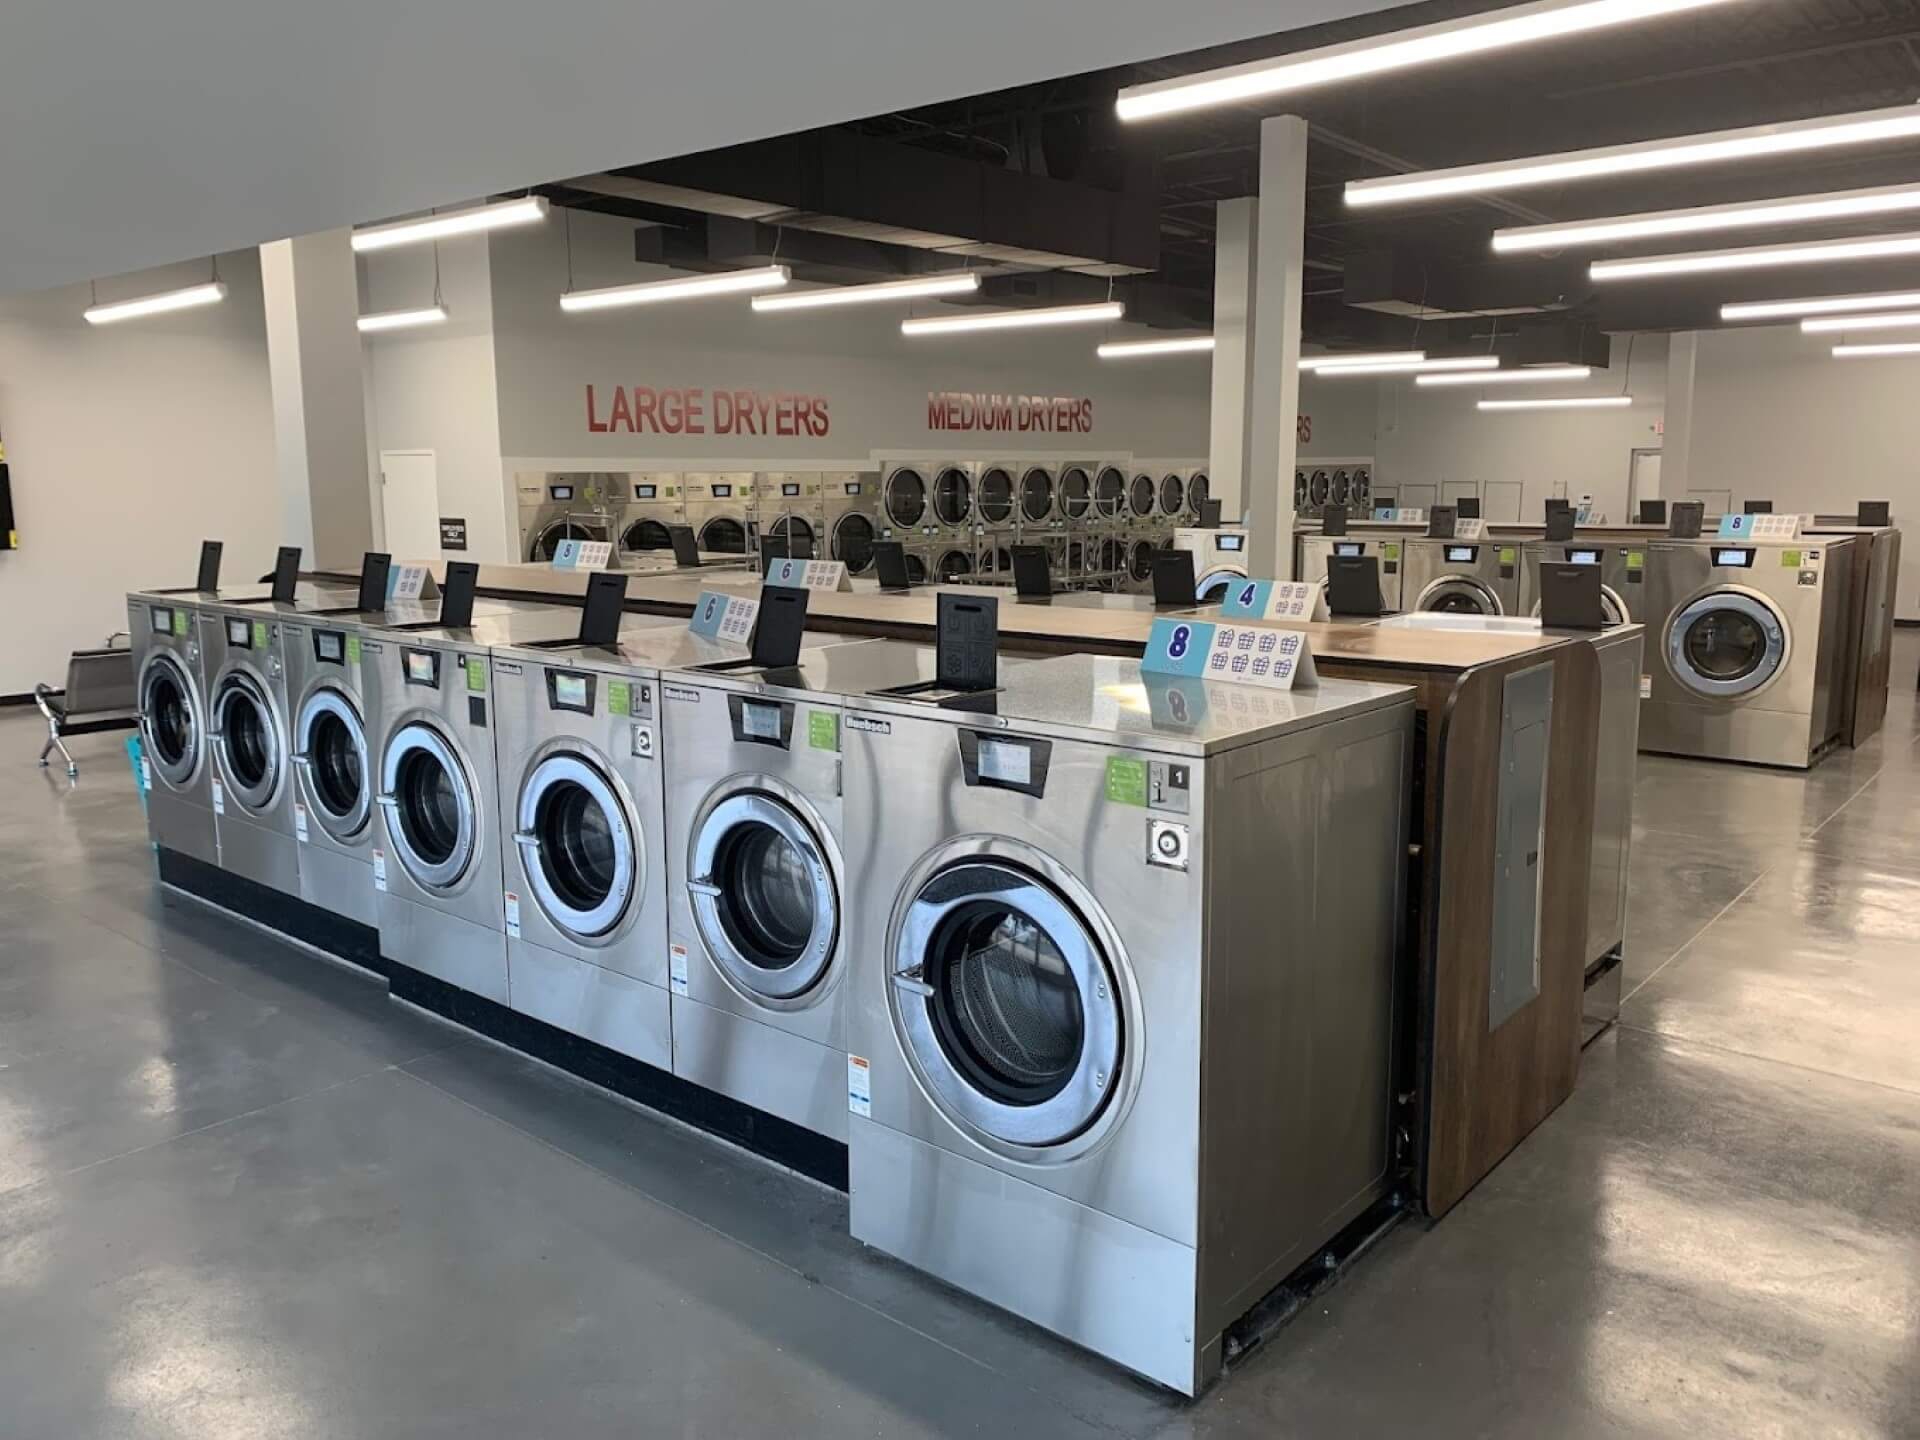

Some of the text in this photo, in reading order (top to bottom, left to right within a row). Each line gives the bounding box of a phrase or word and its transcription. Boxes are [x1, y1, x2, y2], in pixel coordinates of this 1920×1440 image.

[586, 384, 829, 437] LARGE DRYERS
[928, 391, 1092, 433] MEDIUM DRYERS
[781, 562, 793, 580] 6
[1239, 583, 1256, 606] 4
[704, 597, 716, 621] 6
[1168, 625, 1191, 658] 8
